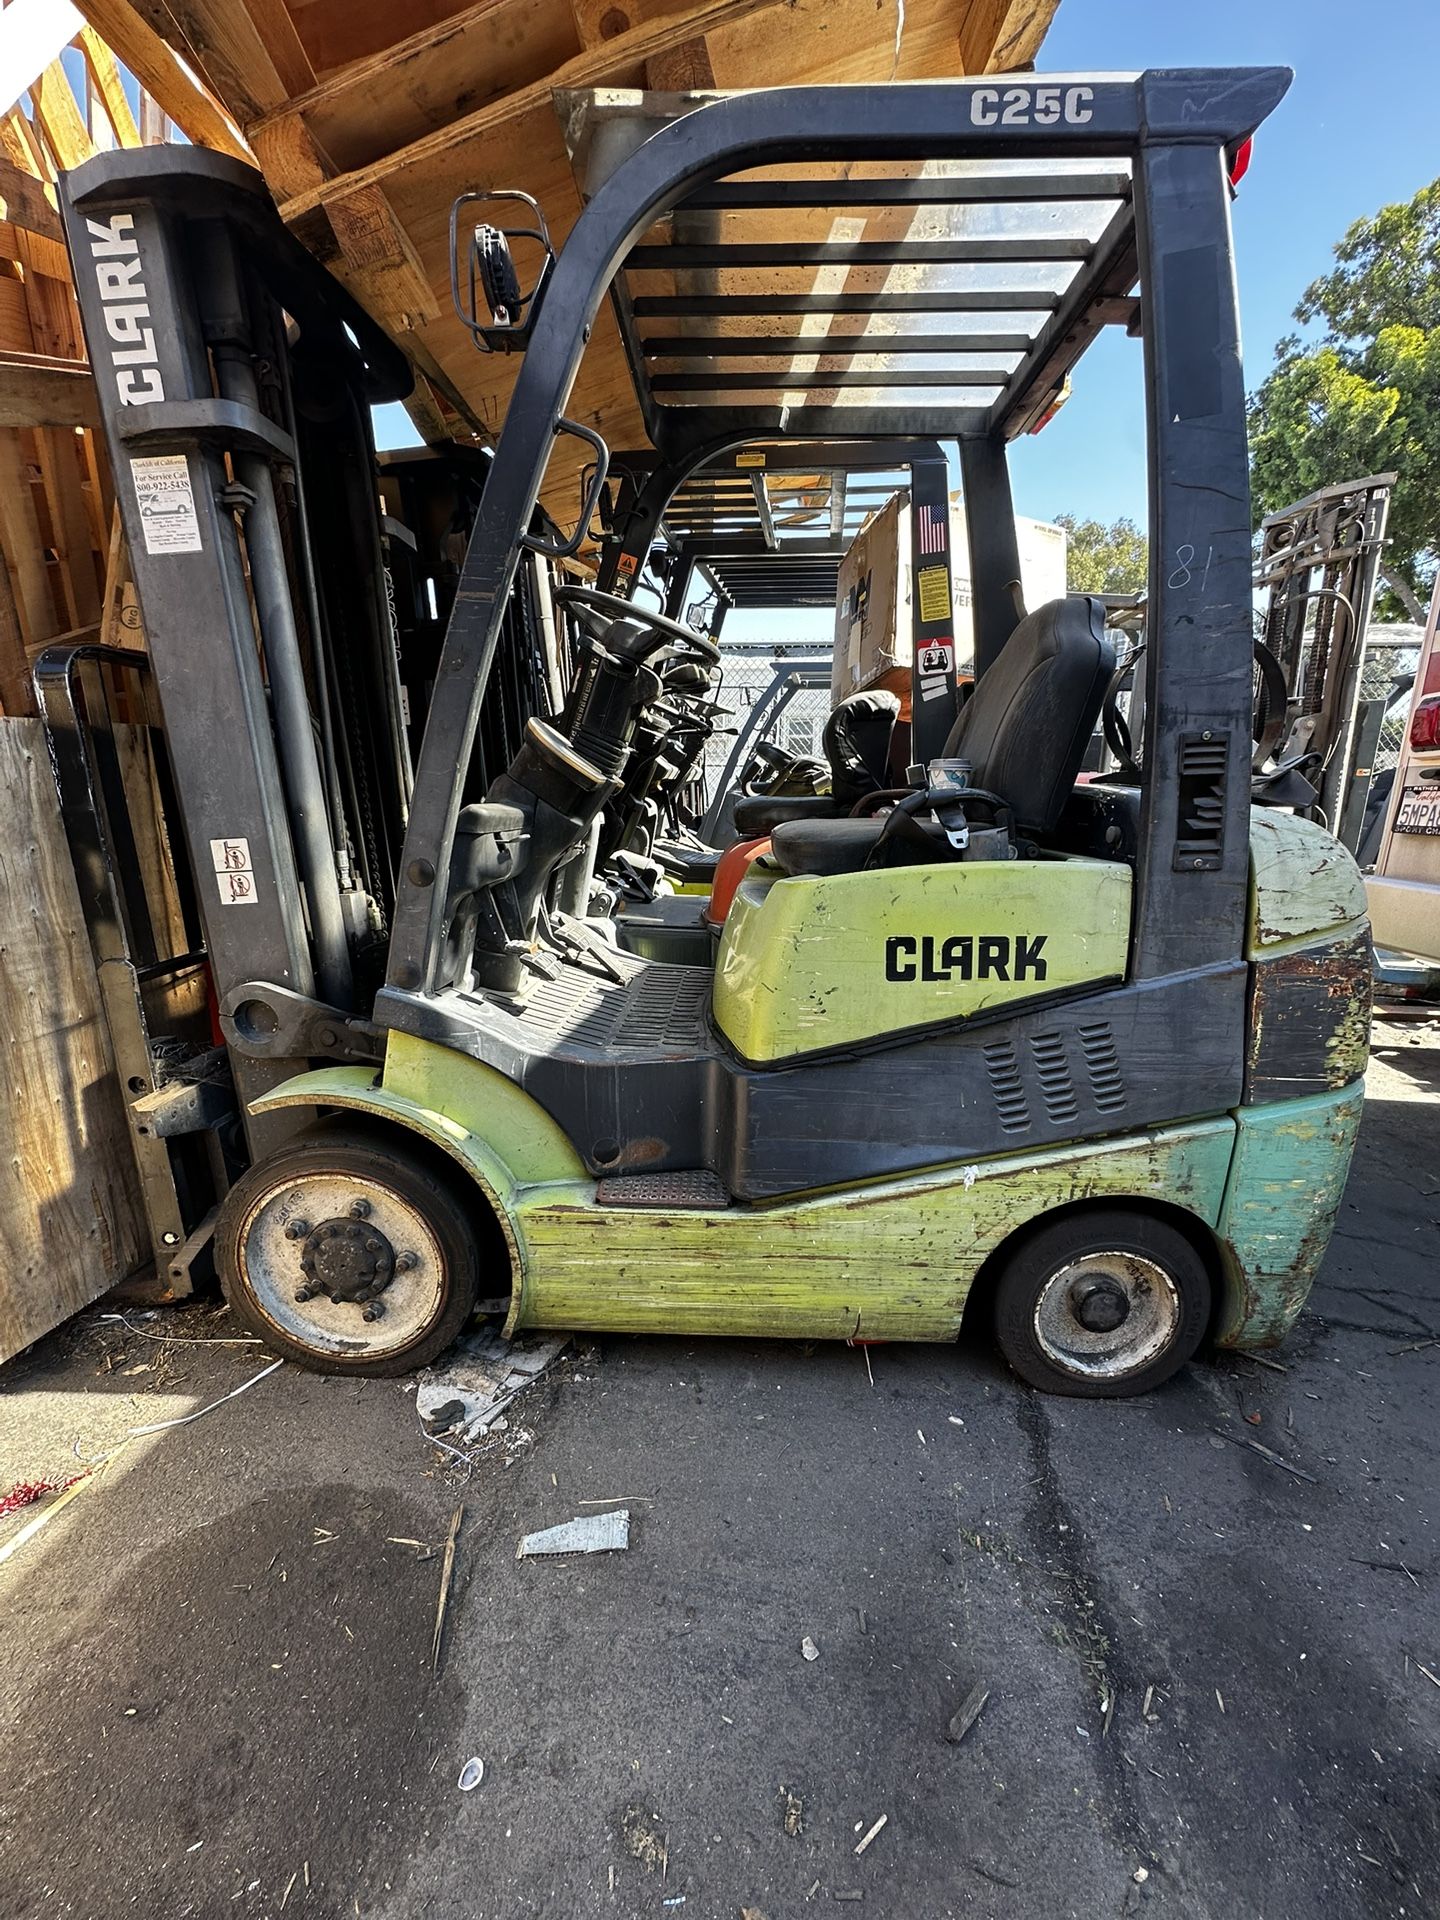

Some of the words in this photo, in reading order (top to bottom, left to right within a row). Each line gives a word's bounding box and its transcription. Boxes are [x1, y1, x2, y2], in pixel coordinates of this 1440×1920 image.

[970, 87, 1094, 125] C25C
[86, 214, 165, 406] CLARK
[136, 481, 190, 492] 800-922-5438
[148, 473, 172, 481] Service
[173, 471, 188, 480] Call
[1168, 544, 1213, 592] 81
[886, 935, 1048, 981] CLARK
